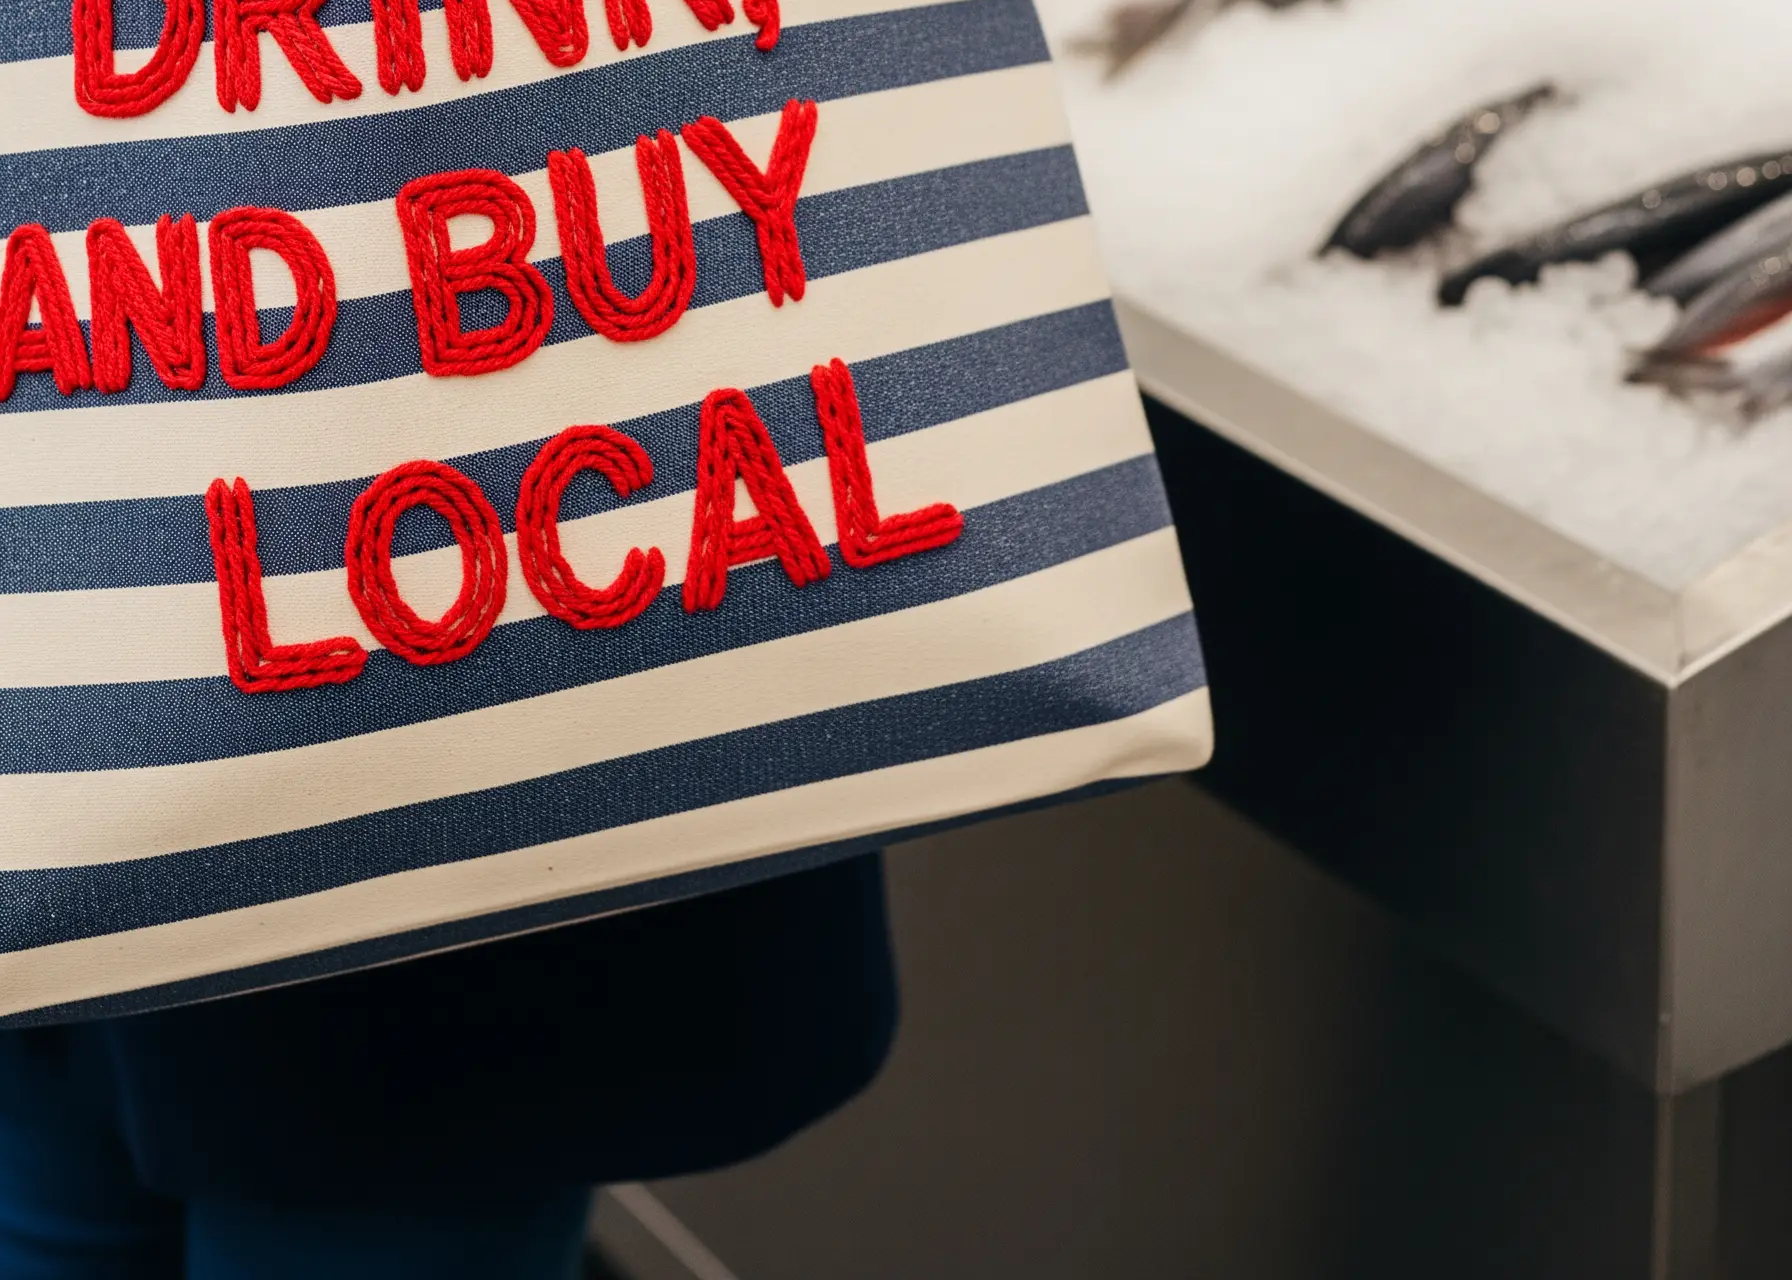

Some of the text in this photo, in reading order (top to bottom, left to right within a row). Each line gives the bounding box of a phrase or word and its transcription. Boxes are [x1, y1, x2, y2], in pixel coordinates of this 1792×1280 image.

[0, 99, 818, 400] AND BUY
[204, 357, 964, 694] LOCAL
